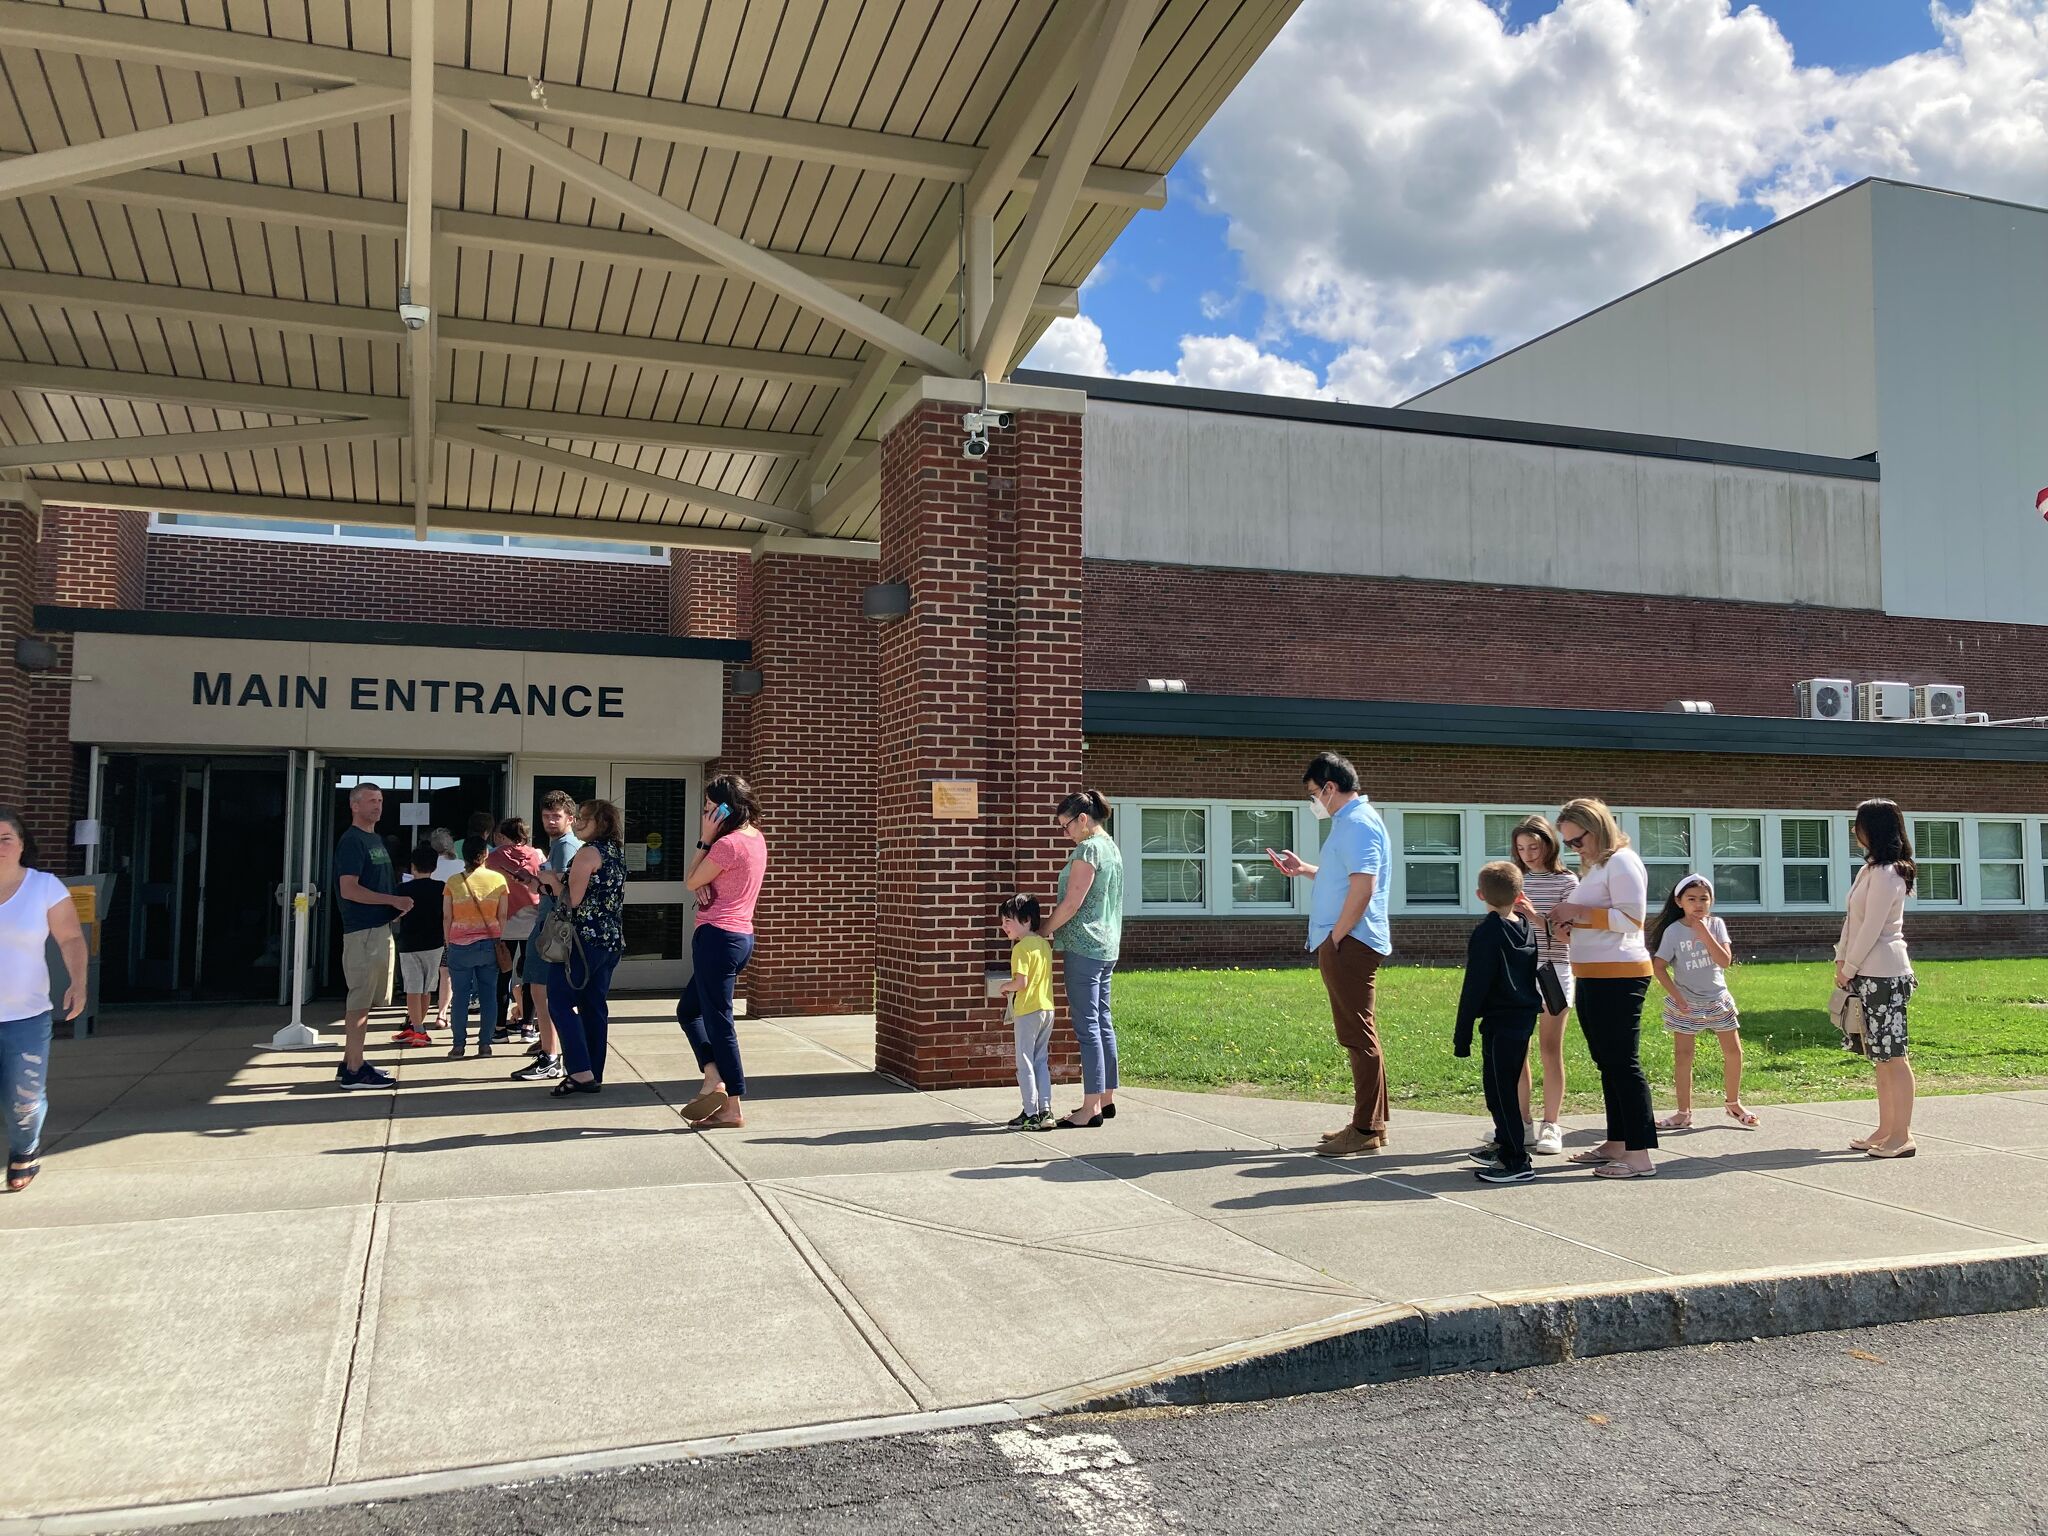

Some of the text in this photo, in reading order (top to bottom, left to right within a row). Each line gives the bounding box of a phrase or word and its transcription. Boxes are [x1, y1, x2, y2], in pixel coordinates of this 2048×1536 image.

[192, 671, 624, 718] MAIN ENTRANCE
[1686, 957, 1711, 970] FAMI
